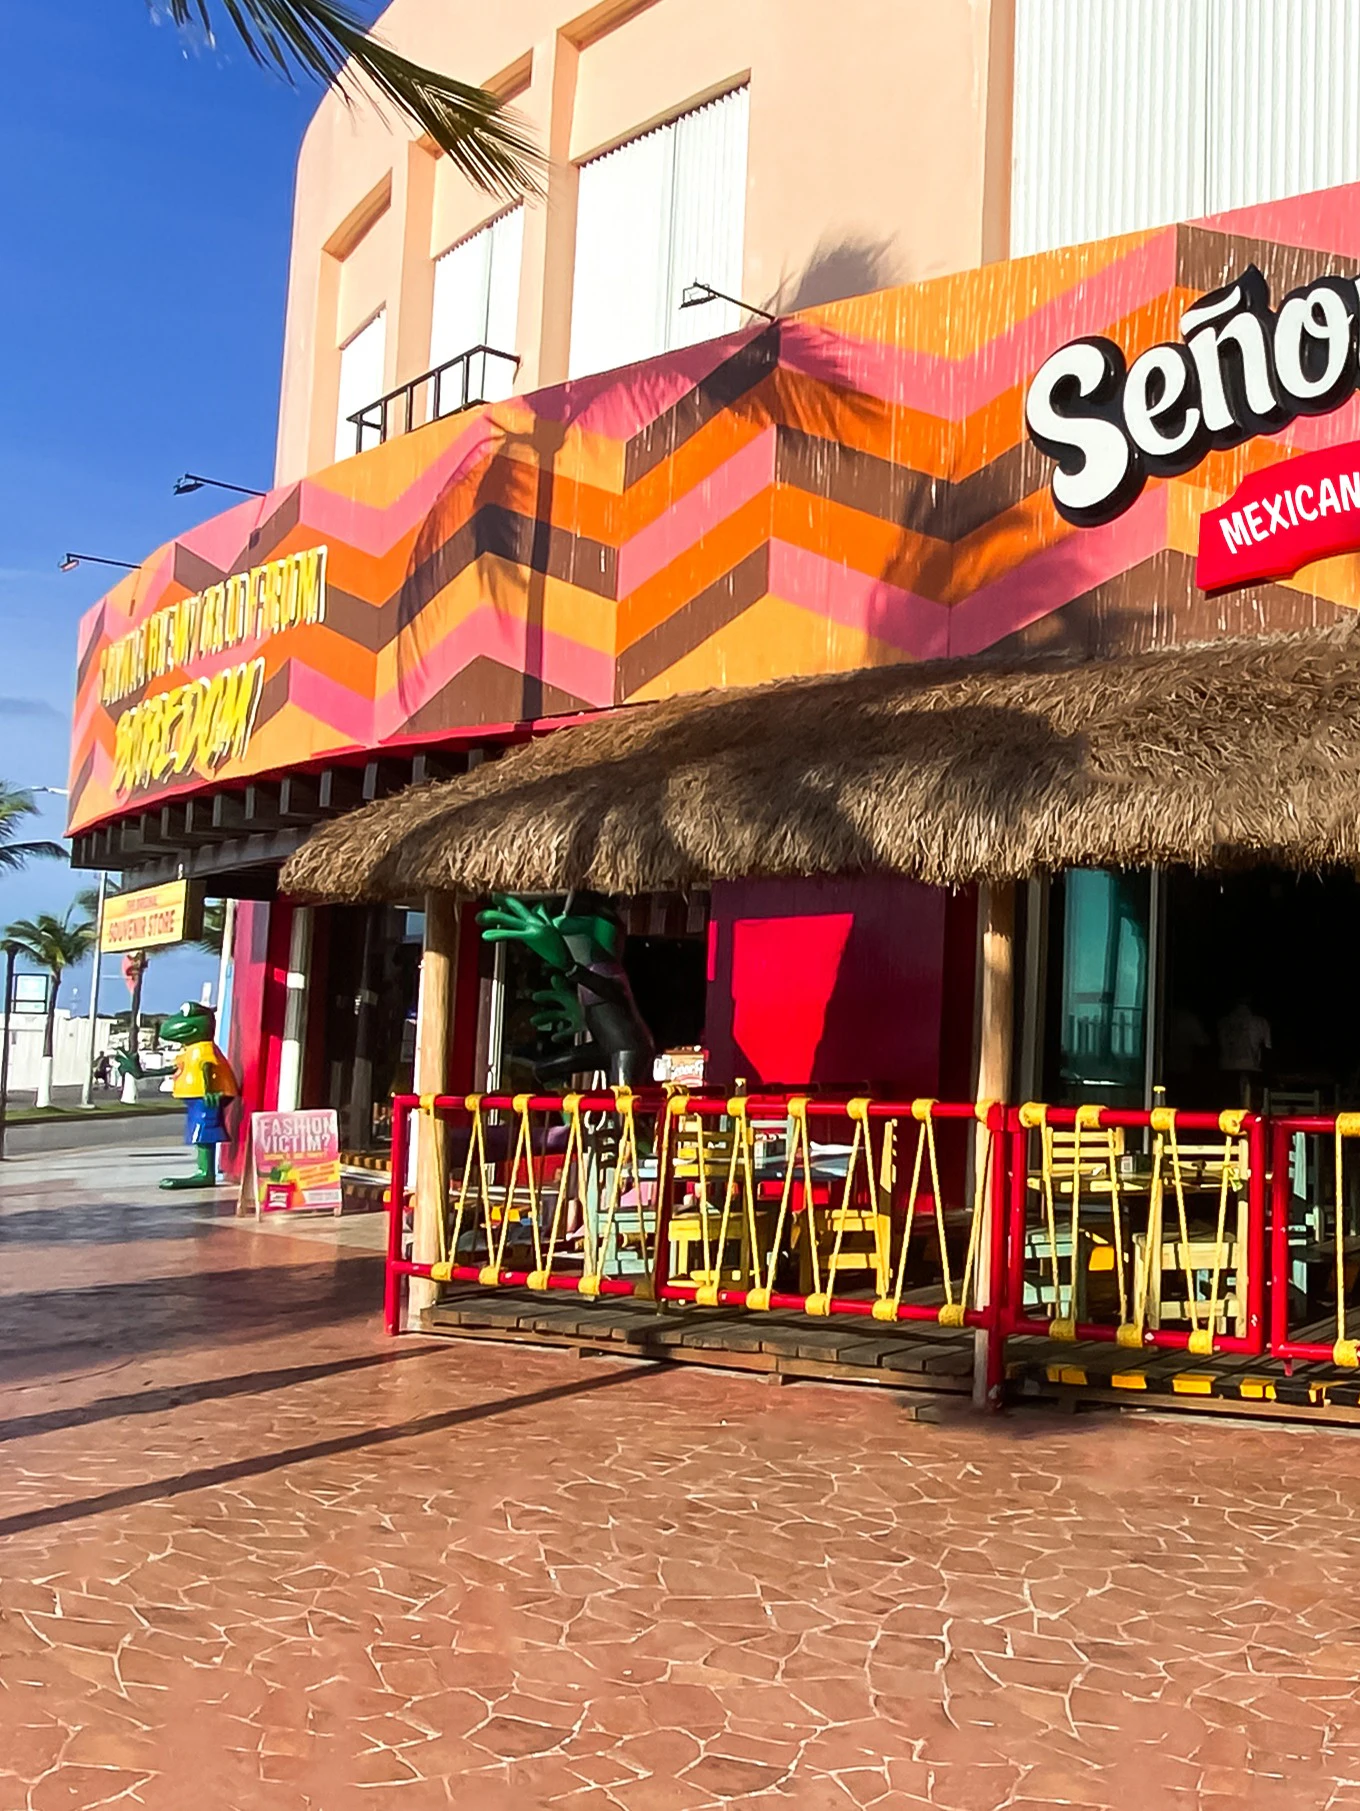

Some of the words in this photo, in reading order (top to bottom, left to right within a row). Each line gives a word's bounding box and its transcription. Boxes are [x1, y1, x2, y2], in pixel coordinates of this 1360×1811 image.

[147, 909, 176, 937] STORE
[260, 1117, 338, 1136] FASHION
[259, 1135, 331, 1153] VICTIM?
